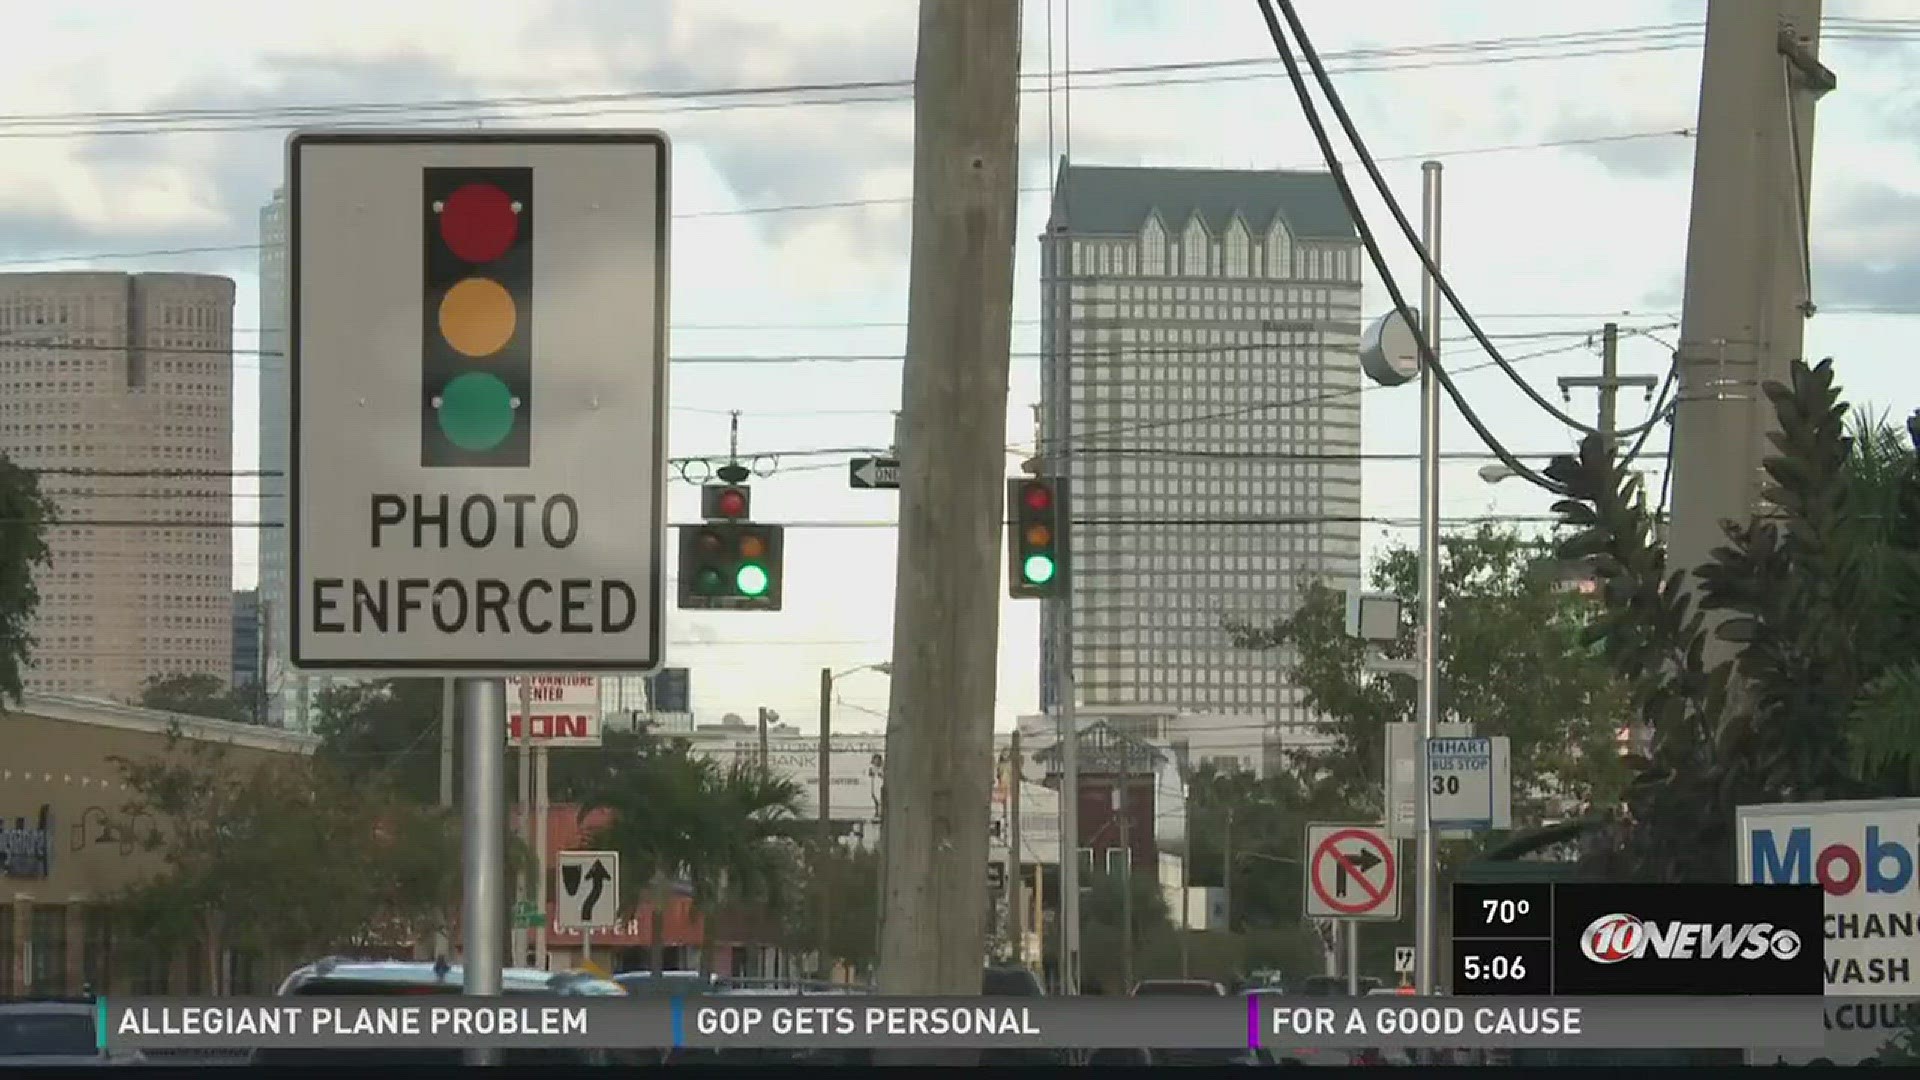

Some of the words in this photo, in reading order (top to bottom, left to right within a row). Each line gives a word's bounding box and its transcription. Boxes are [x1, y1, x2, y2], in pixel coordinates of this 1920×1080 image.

[371, 494, 578, 548] PHOTO
[313, 579, 637, 633] ENFORCED
[518, 686, 564, 701] NTER
[1432, 760, 1454, 770] BUS
[1457, 760, 1488, 770] STOP
[1432, 775, 1460, 795] 30
[1752, 826, 1920, 896] Mob
[1824, 912, 1920, 939] CHAN
